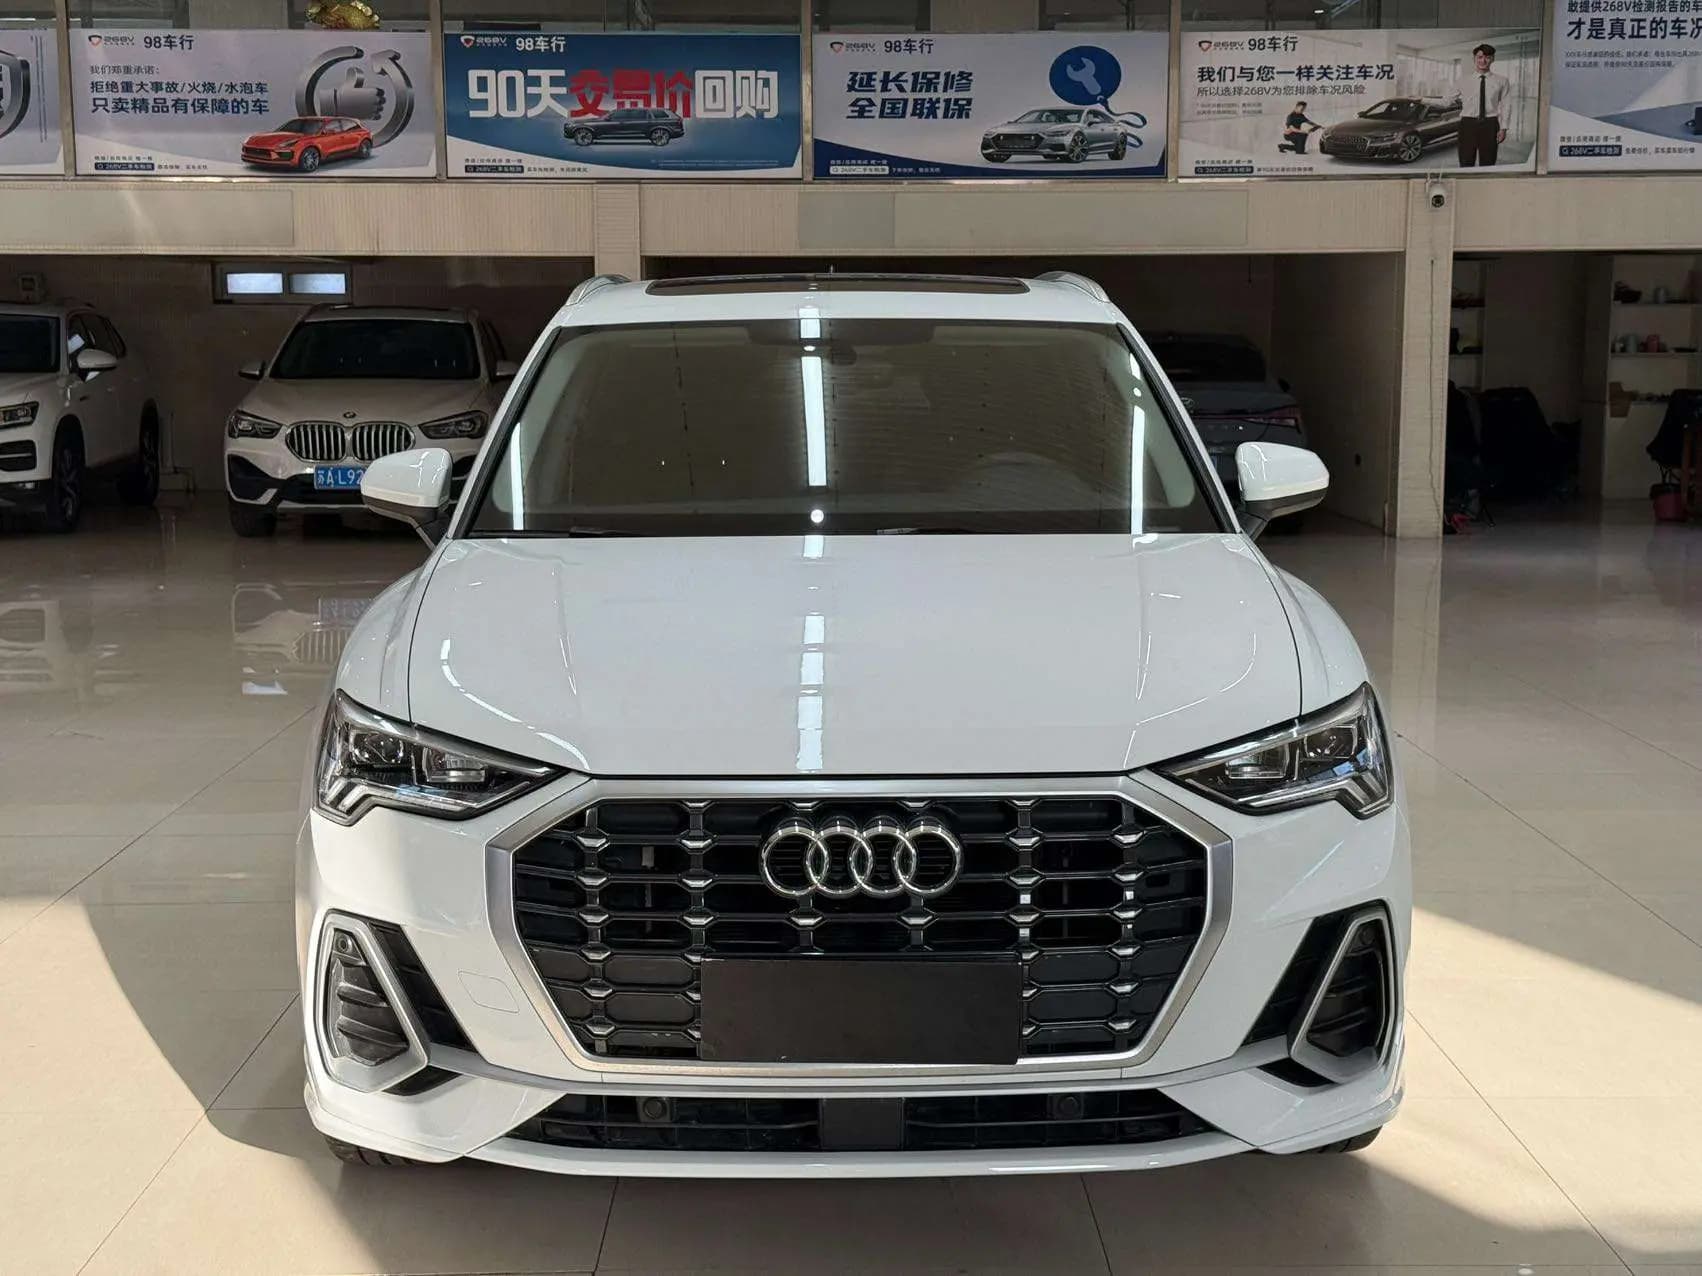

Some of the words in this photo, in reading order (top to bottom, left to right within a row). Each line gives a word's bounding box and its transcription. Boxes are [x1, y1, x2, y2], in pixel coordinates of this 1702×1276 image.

[143, 35, 194, 50] 98车行
[516, 36, 566, 52] 98车行
[884, 39, 934, 54] 98车行
[1248, 36, 1299, 52] 98车行
[1197, 64, 1395, 83] 我们与您一样关注车况
[90, 81, 269, 95] 拒绝重大事故/火烧/水泡车
[846, 71, 973, 93] 延长保修
[467, 68, 779, 119] 90天交易价回购
[1197, 85, 1367, 97] 所以选择268V为您排除车况风险
[91, 97, 270, 115] 只卖精品有保障的车
[846, 97, 973, 119] 全国联保
